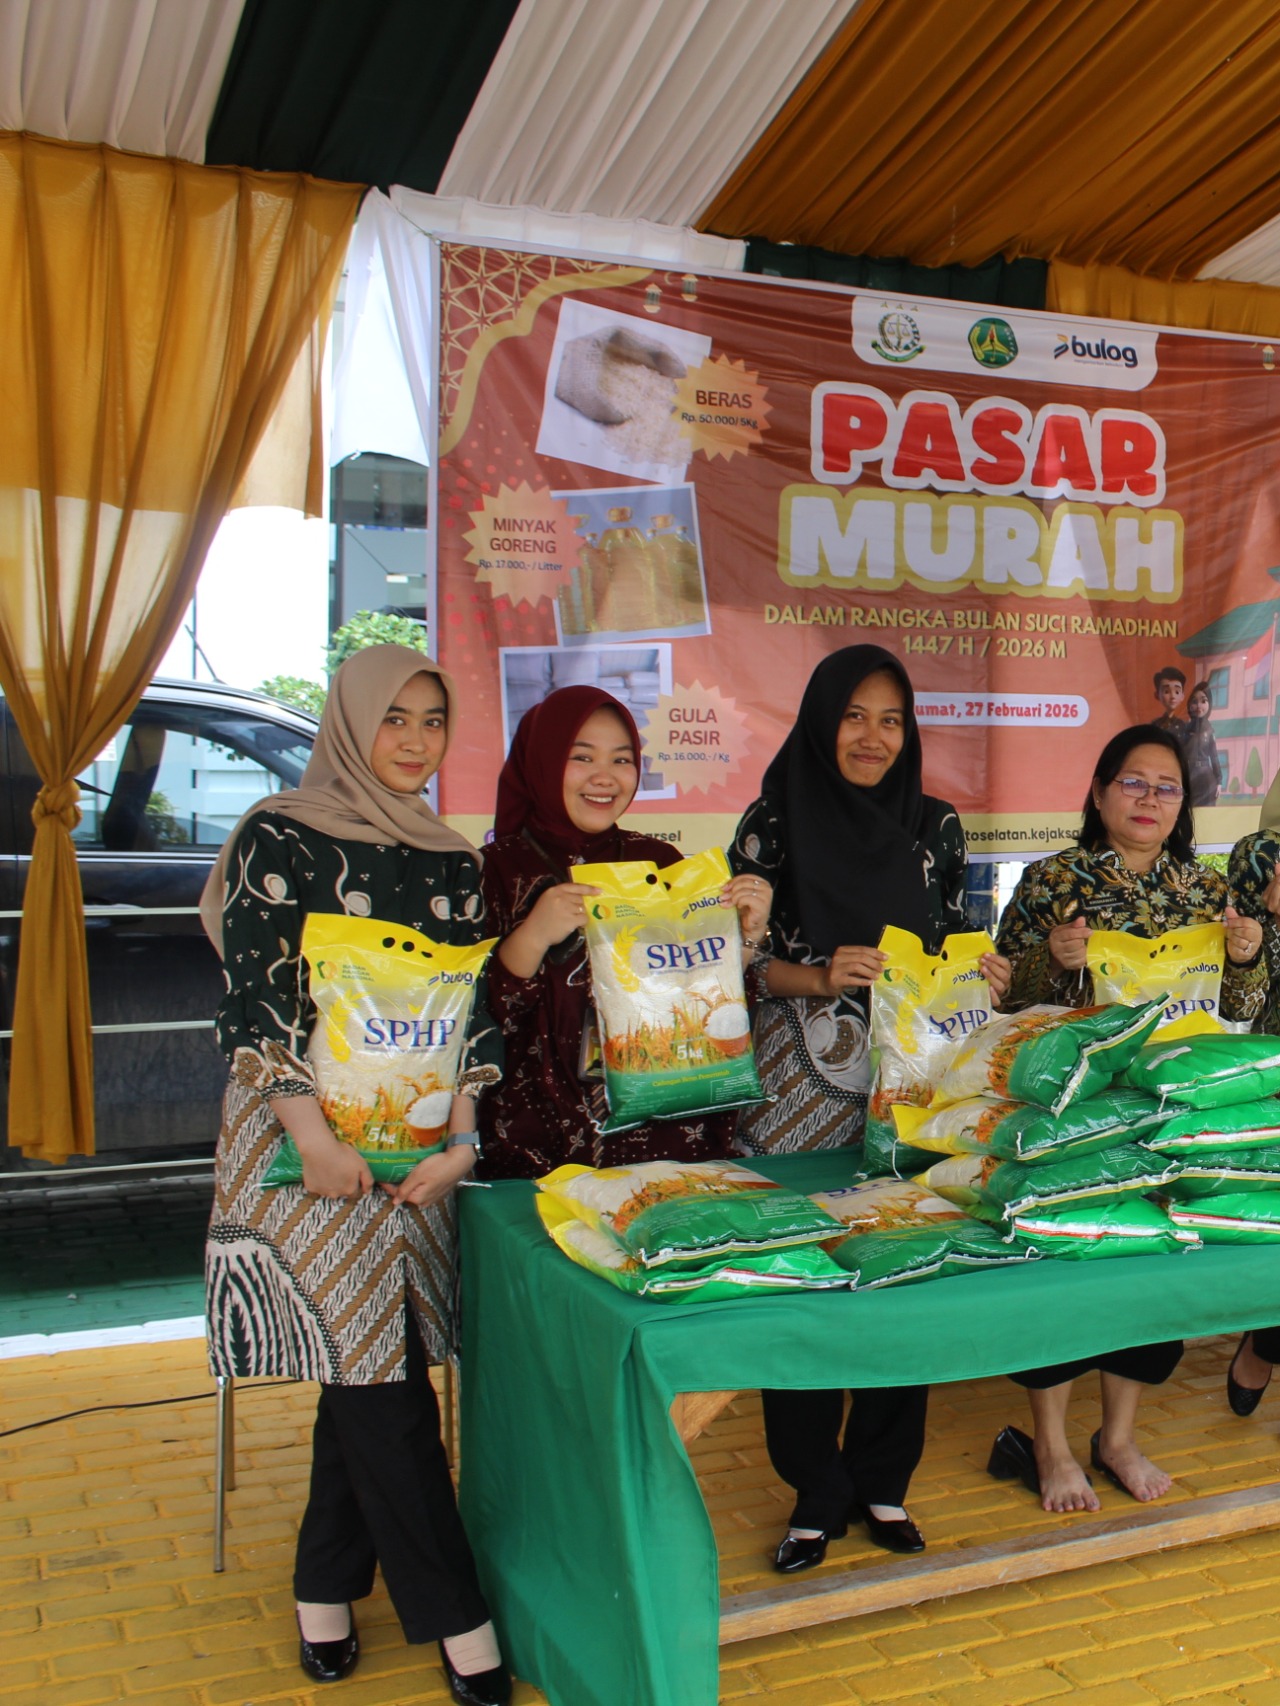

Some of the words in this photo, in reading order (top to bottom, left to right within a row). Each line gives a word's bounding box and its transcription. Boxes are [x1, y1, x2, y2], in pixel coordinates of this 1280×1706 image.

[1071, 335, 1138, 368] bulog
[696, 389, 753, 409] BERAS
[681, 412, 697, 424] Rp.
[821, 391, 1158, 498] PASAR
[493, 518, 557, 534] MINYAK
[490, 538, 557, 554] GORENG
[788, 494, 1176, 594] MURAH
[478, 559, 494, 570] Rp.
[538, 562, 563, 571] Litter
[764, 604, 845, 626] DALAM
[851, 607, 948, 629] RANGKA
[953, 610, 1021, 631] BULAN
[1024, 613, 1067, 633] SUCI
[1071, 615, 1178, 638] RAMADHAN
[903, 635, 953, 655] 1447
[958, 636, 975, 656] H
[980, 637, 992, 658] /
[996, 638, 1046, 658] 2026
[1049, 640, 1067, 659] M
[669, 708, 718, 723] GULA
[915, 702, 961, 718] umat,
[965, 702, 983, 716] 27
[987, 702, 1042, 717] Februari
[1045, 703, 1079, 718] 2026
[669, 730, 720, 745] PASIR
[658, 752, 672, 762] Rp.
[718, 752, 730, 763] Kg
[646, 830, 682, 842] arsel
[964, 827, 1080, 843] toselatan.kejaksa
[646, 936, 726, 969] SPHP
[1186, 962, 1220, 974] bulog
[1163, 998, 1216, 1020] PHP
[363, 1017, 457, 1047] SPHP
[928, 1009, 989, 1039] SPHP
